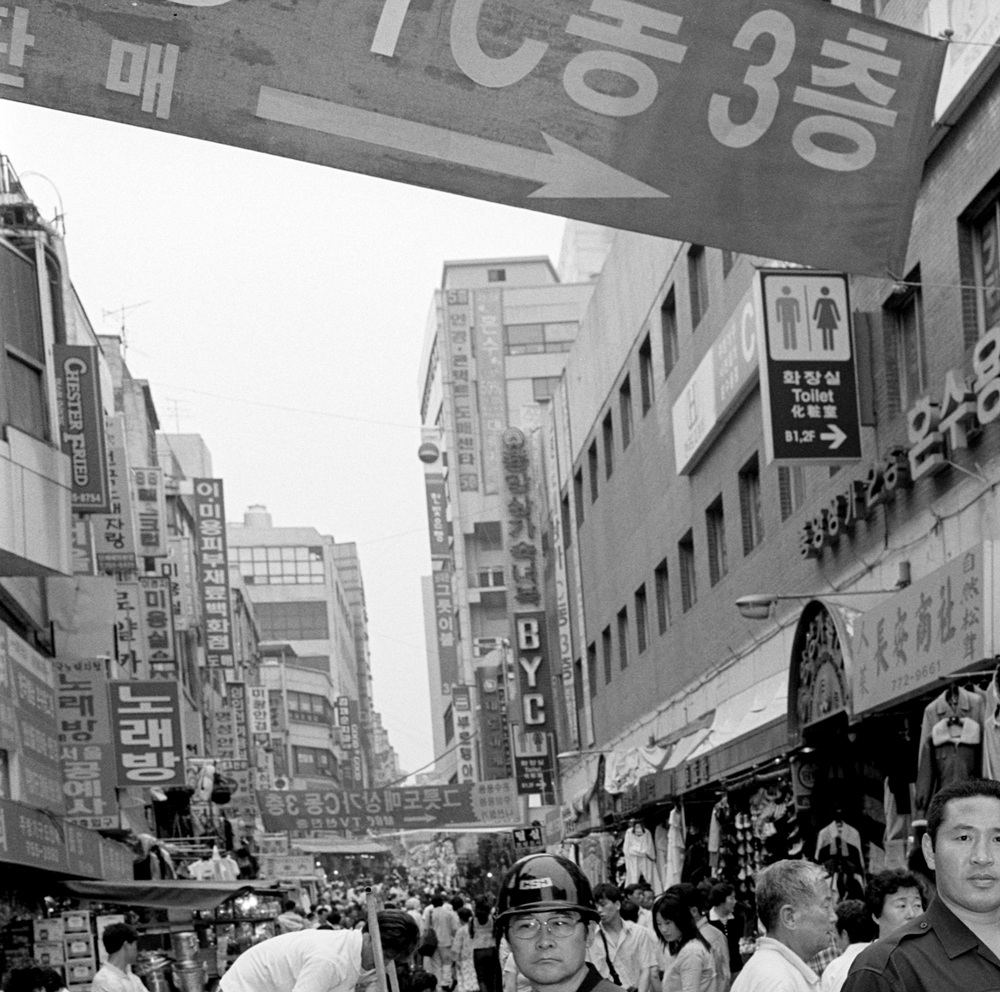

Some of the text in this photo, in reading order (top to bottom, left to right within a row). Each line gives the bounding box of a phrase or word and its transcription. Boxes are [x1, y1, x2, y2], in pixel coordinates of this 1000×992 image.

[782, 370, 841, 386] 화장실
[791, 388, 834, 403] Toilet
[791, 404, 838, 419] 化粧室
[63, 357, 89, 486] CHESTER FRIED
[785, 429, 816, 443] B1,2F
[516, 617, 547, 726] BYC
[117, 685, 181, 782] 노래방
